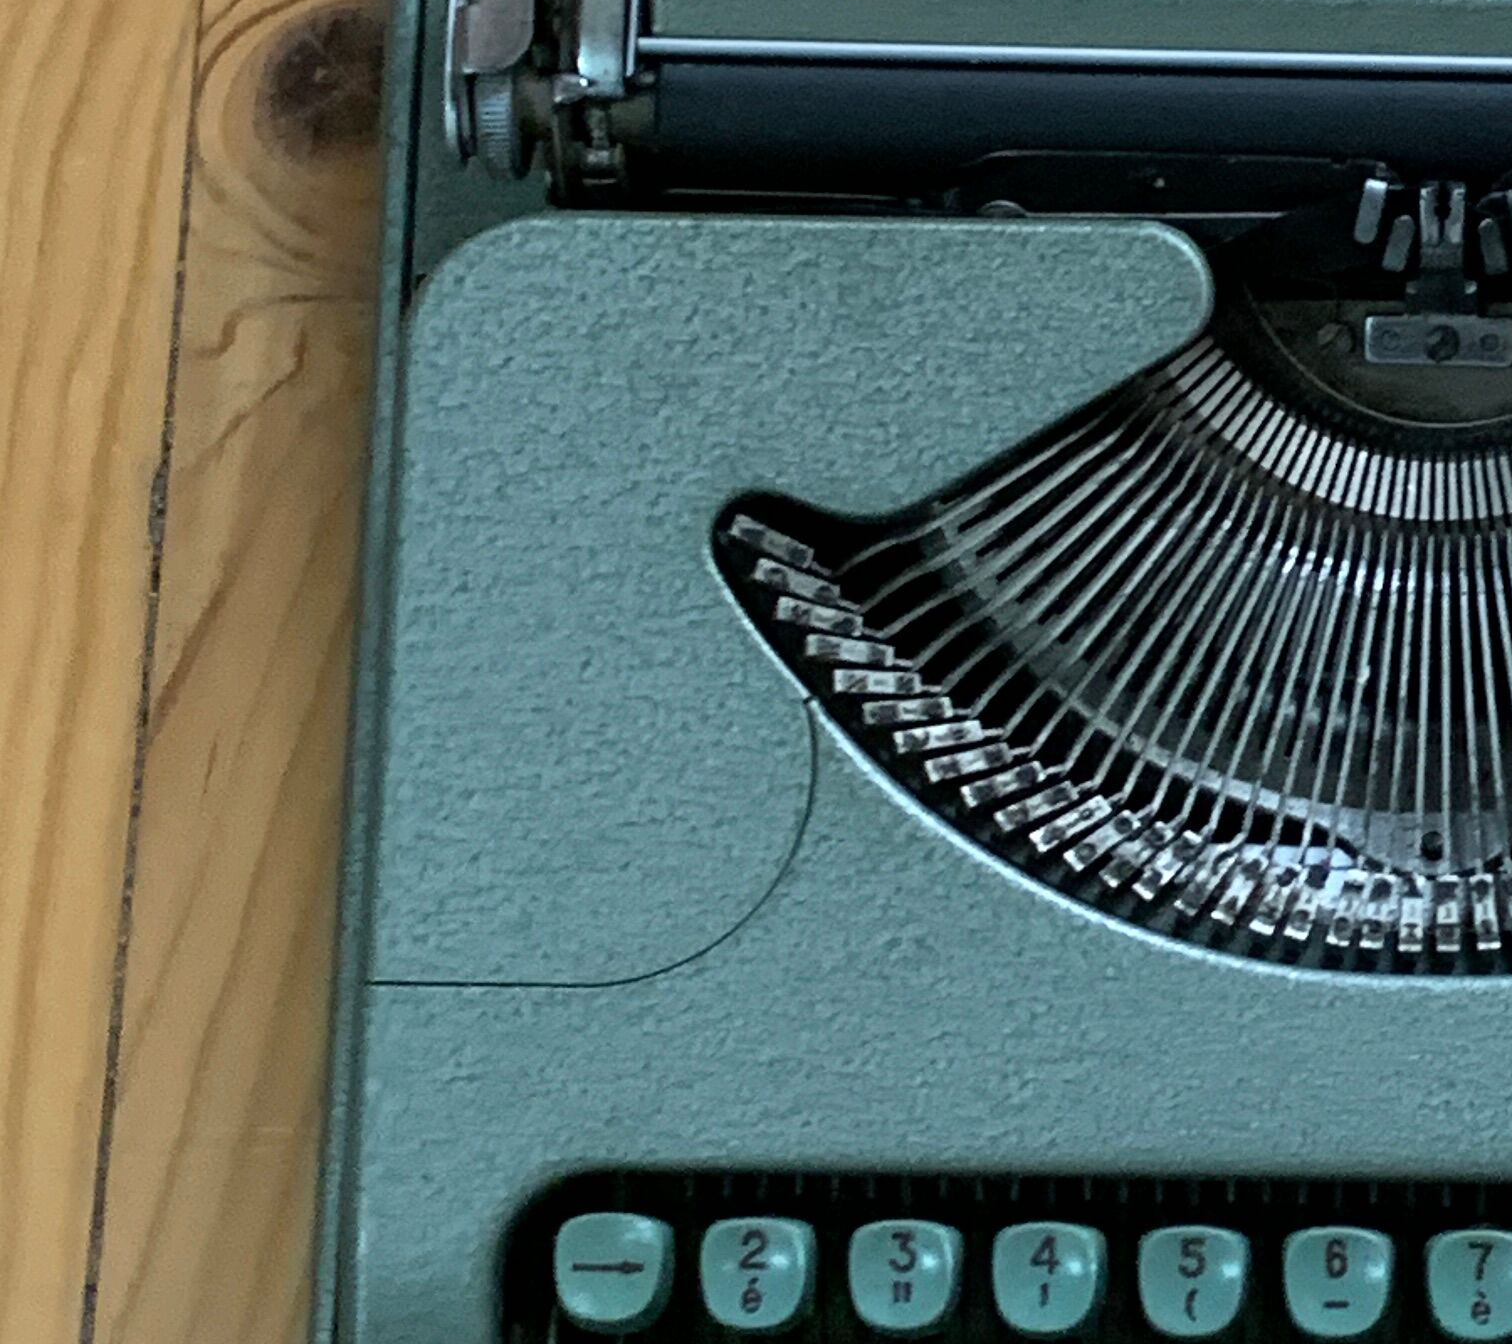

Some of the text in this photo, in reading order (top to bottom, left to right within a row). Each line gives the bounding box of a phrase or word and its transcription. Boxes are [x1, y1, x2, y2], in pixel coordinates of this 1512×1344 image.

[739, 1229, 767, 1270] 2
[889, 1231, 917, 1273] 3
[1030, 1236, 1058, 1275] 4
[1178, 1238, 1206, 1279] 5
[1325, 1239, 1347, 1279] 6
[1468, 1242, 1493, 1281] 7
[1184, 1287, 1198, 1322] (
[1469, 1291, 1492, 1325] è
